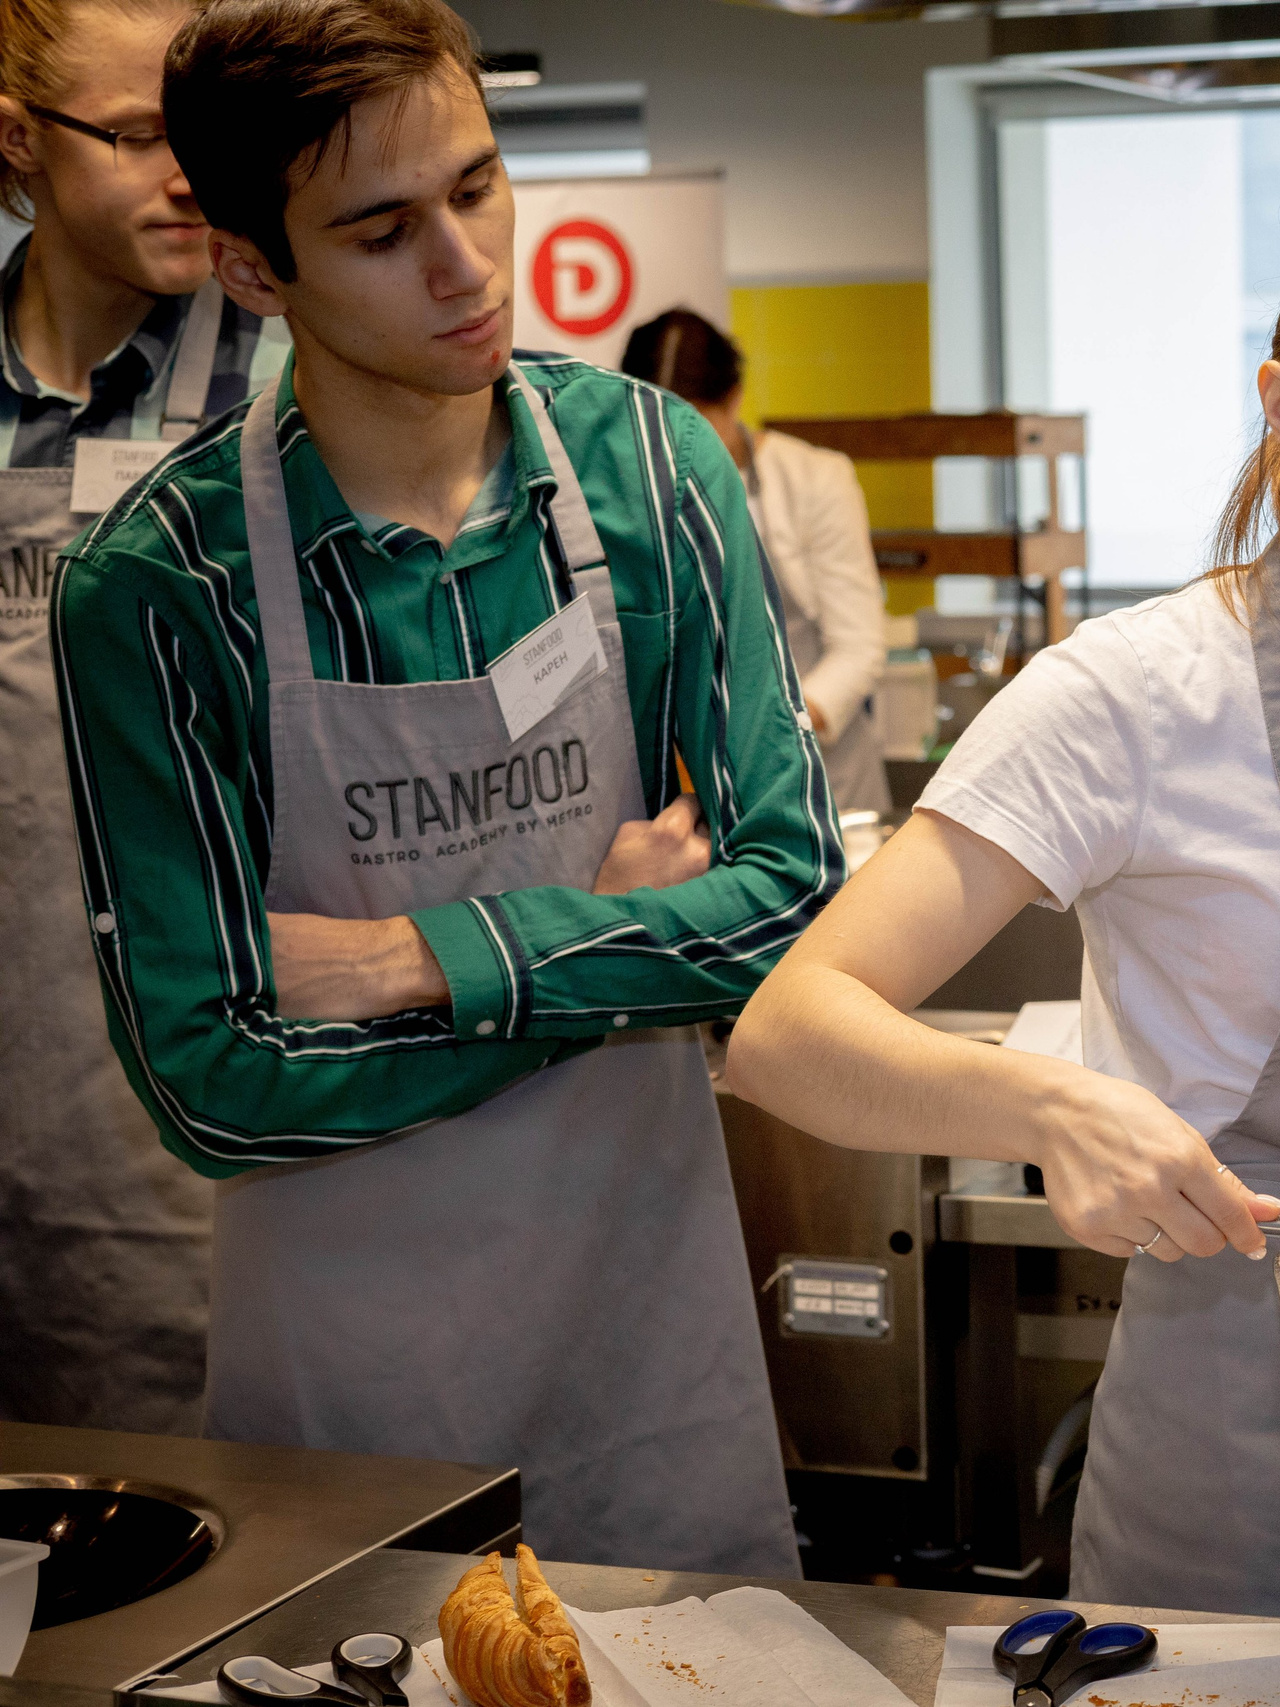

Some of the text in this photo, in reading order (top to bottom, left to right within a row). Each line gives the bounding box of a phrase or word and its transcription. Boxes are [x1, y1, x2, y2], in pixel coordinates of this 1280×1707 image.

[523, 627, 563, 666] STANFOOD
[533, 650, 568, 685] КАРЕН
[344, 738, 589, 842] STANFOOD
[350, 804, 593, 866] GASTRO ACADEMY BY METRO
